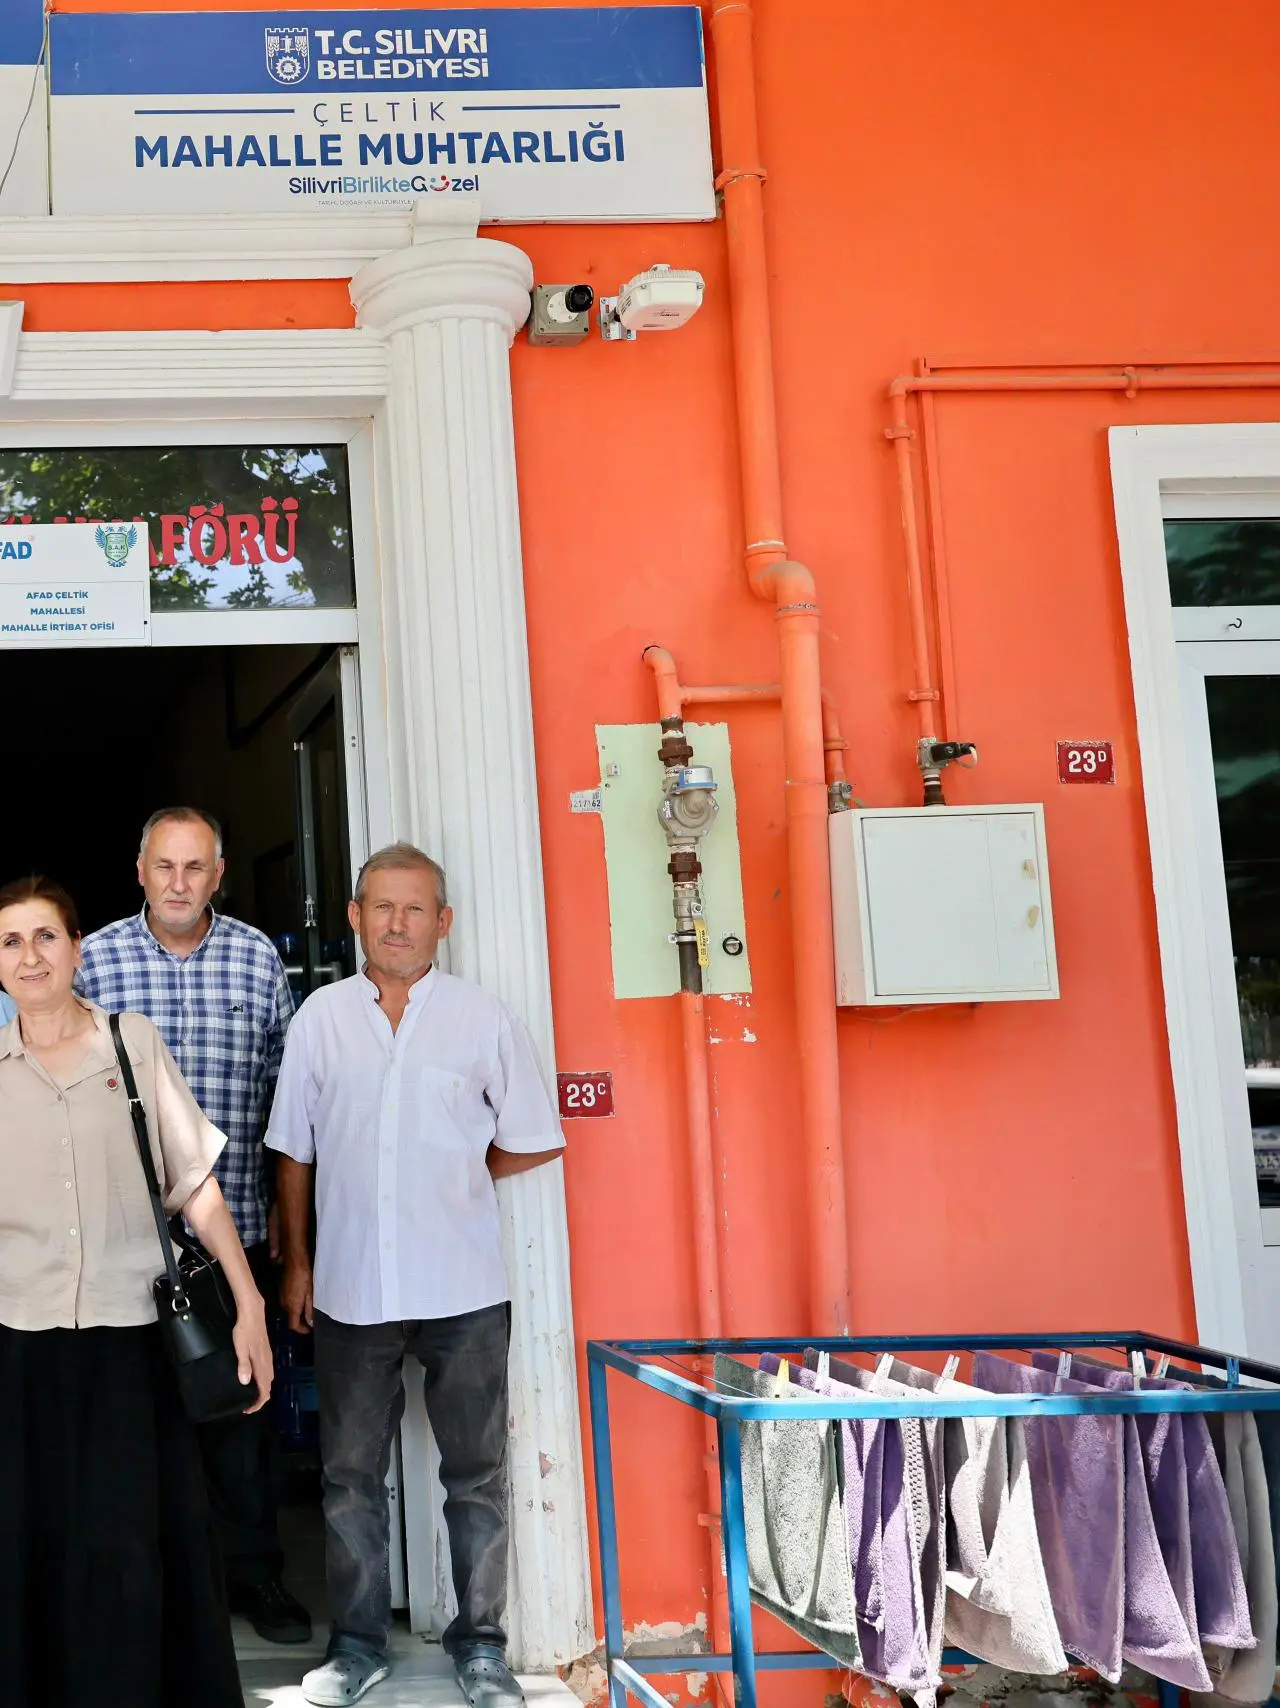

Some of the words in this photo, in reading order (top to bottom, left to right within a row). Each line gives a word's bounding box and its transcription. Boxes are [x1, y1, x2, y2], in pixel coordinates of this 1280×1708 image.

[315, 29, 370, 55] T.C.
[375, 28, 488, 54] SİLİVRİ
[318, 58, 489, 79] BELEDİYESİ
[313, 98, 445, 126] ÇELTİK
[134, 133, 342, 168] MAHALLE
[359, 121, 625, 167] MUHTARLIĞI
[55, 591, 89, 600] ÇELTİK
[30, 607, 85, 615] MAHALLESİ
[1, 623, 48, 632] MAHALLE
[49, 622, 87, 631] İRTİBAT
[90, 621, 115, 630] OFİSİ
